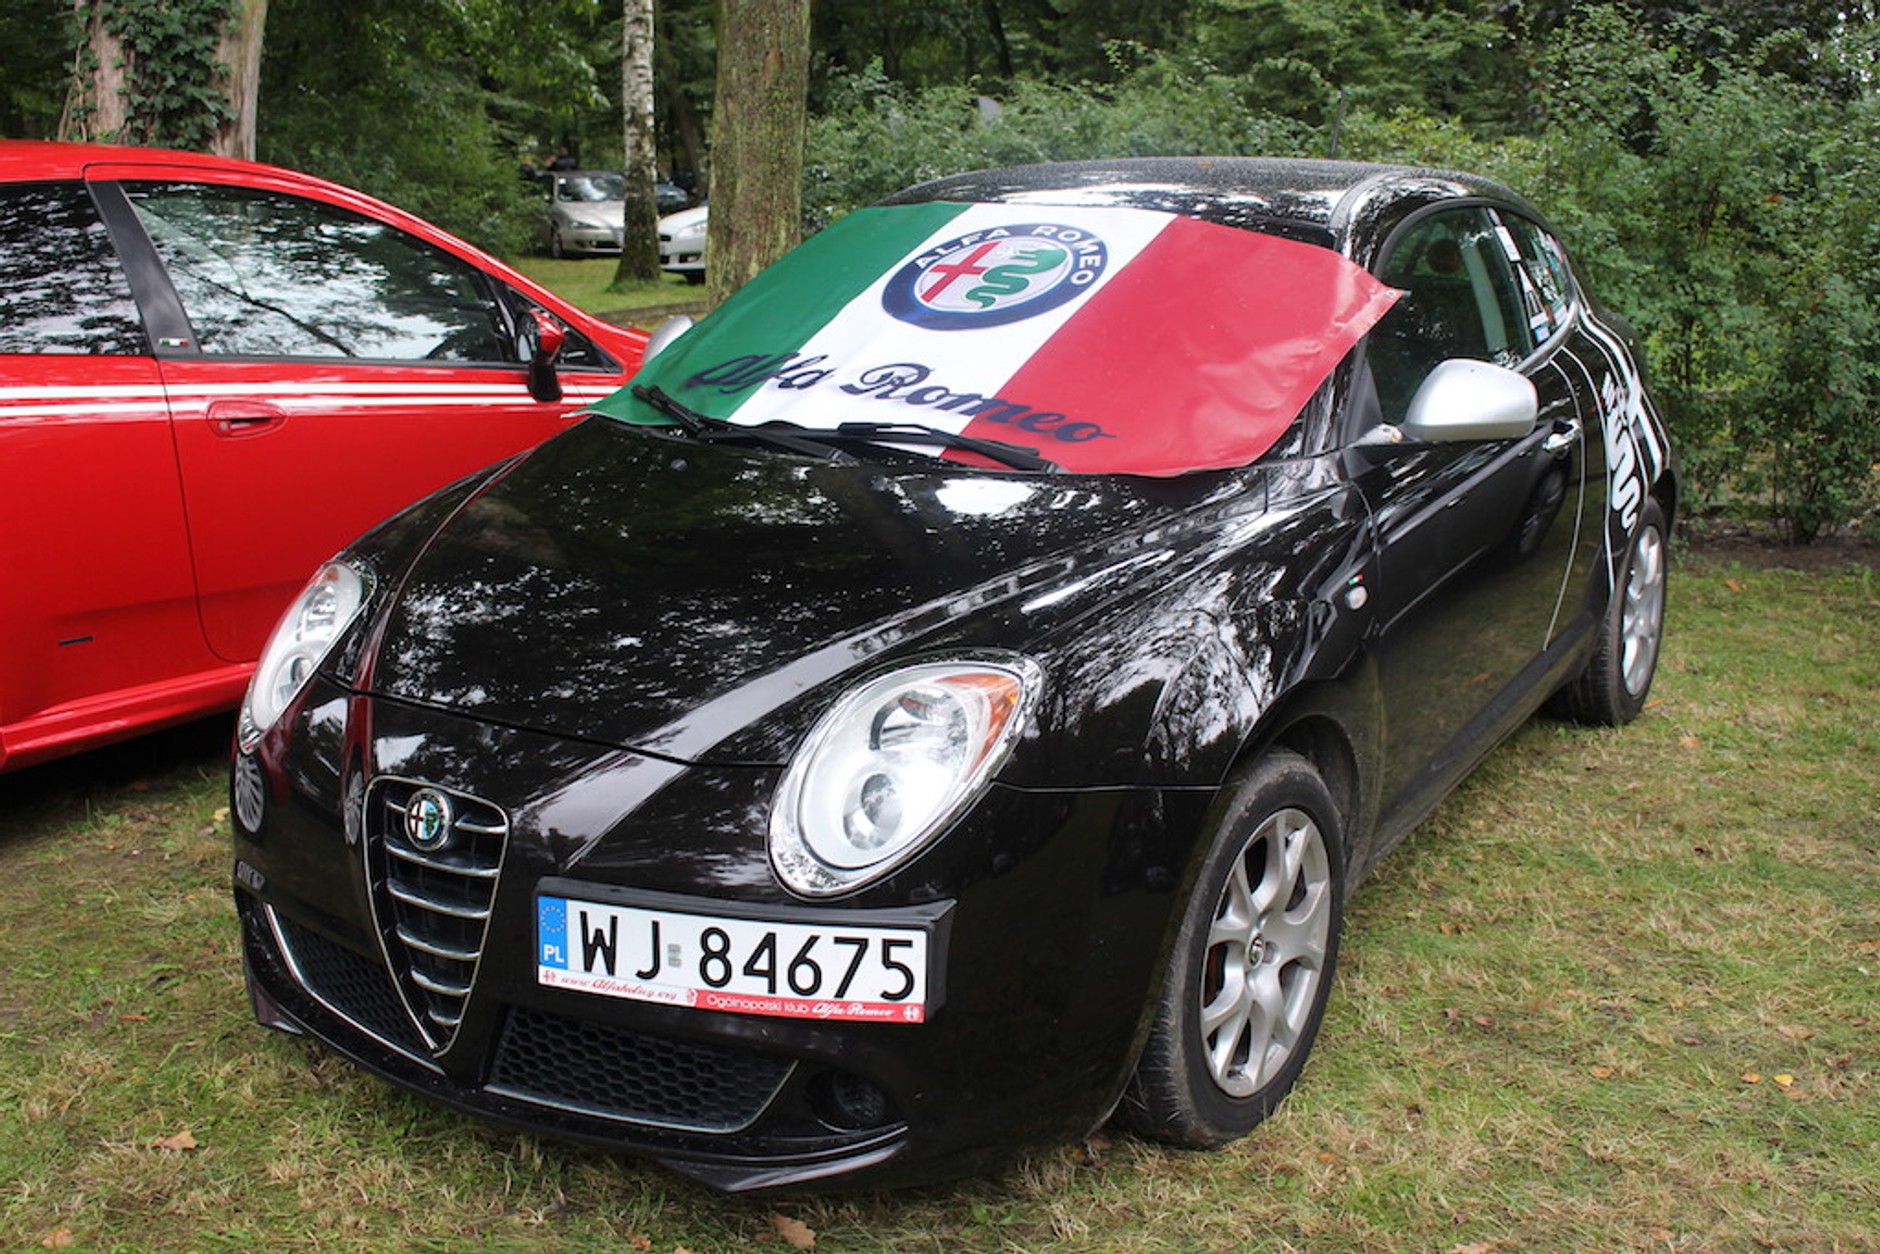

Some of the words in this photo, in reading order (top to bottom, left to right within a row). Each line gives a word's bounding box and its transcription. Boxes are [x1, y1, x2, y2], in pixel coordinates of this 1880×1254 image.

[915, 227, 1012, 269] ALFA
[1031, 224, 1102, 286] ROMEO
[688, 352, 836, 395] Alfa
[839, 362, 1118, 443] Romeo
[543, 944, 565, 964] PL
[699, 926, 915, 1003] 84675
[811, 1003, 846, 1018] Alfa
[847, 1003, 896, 1016] Romeo
